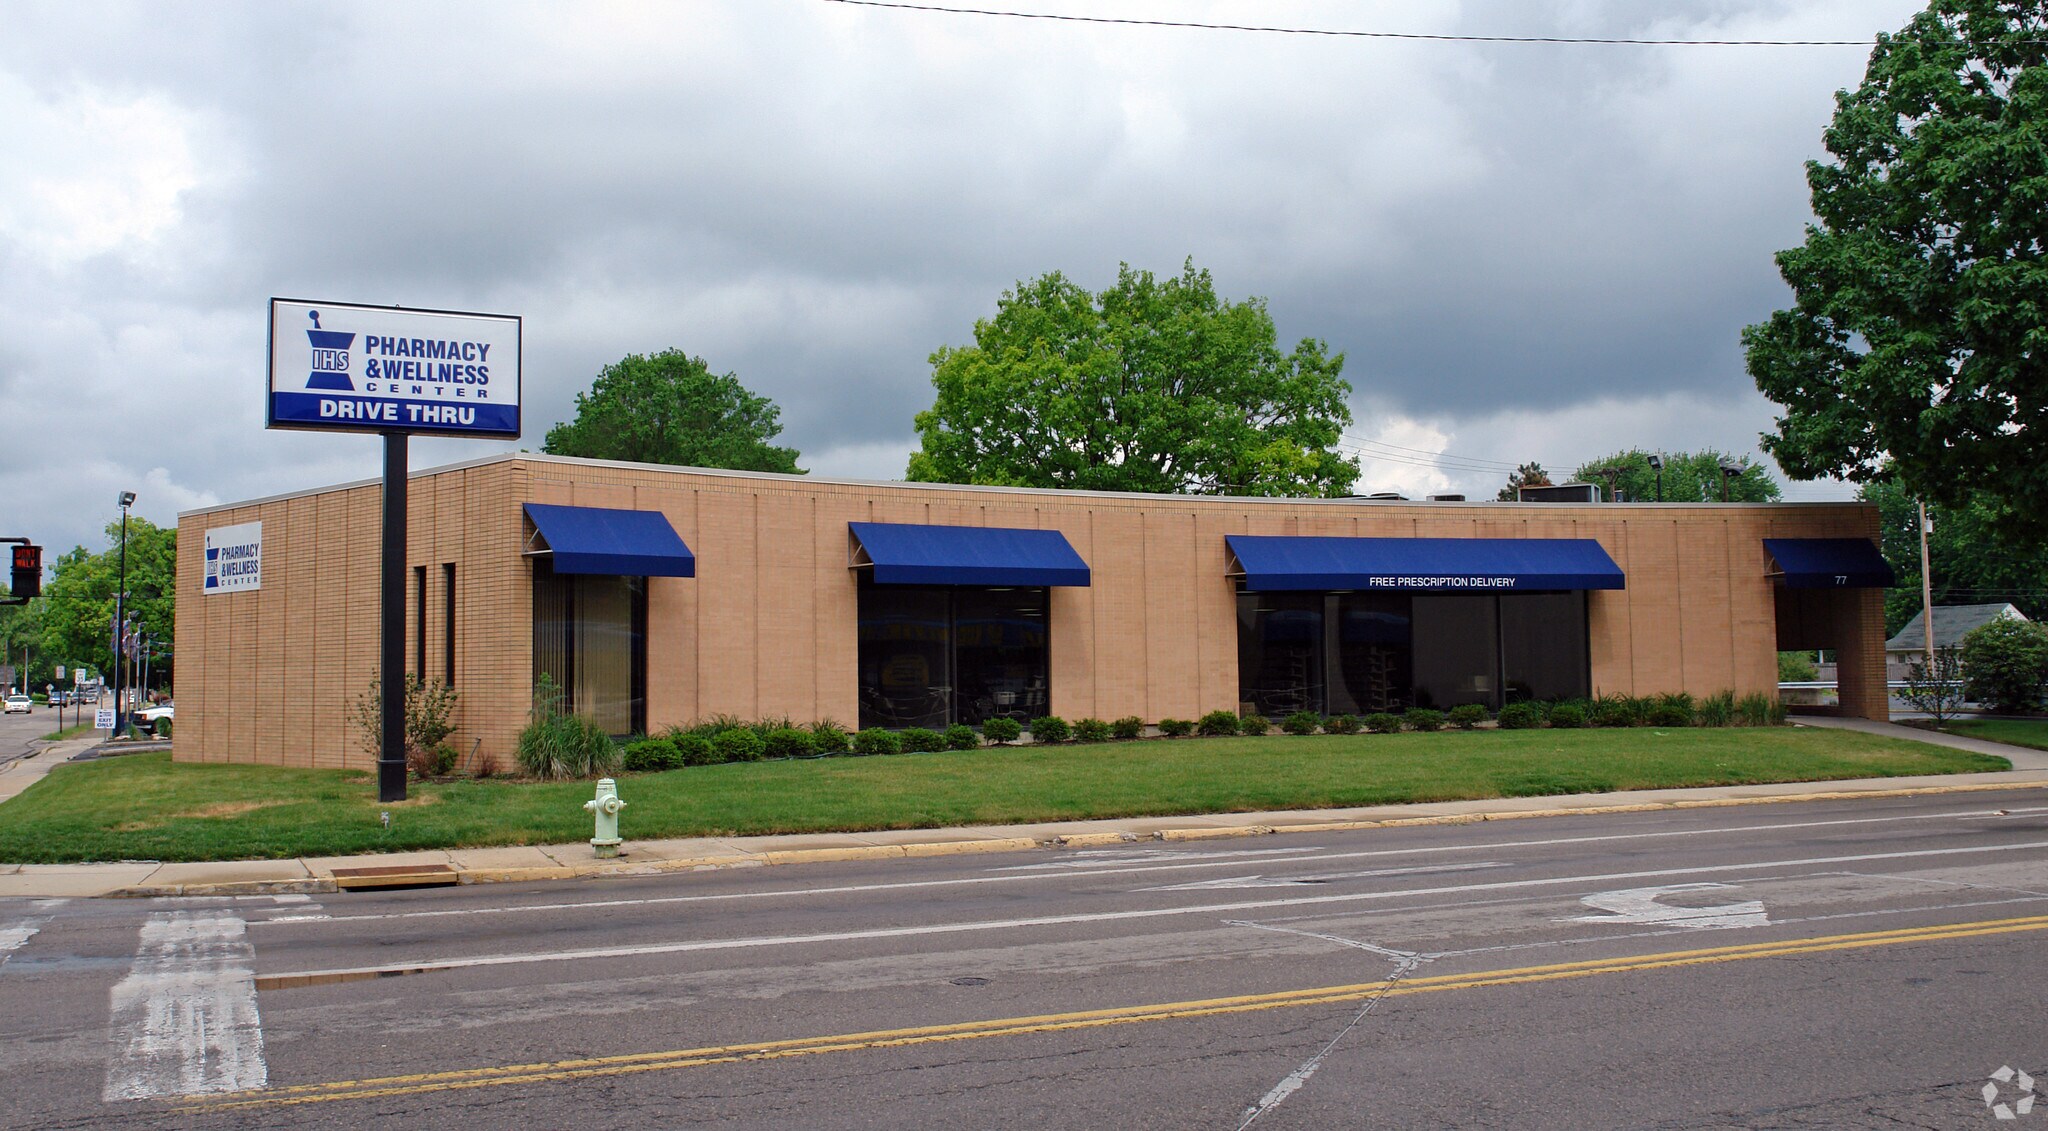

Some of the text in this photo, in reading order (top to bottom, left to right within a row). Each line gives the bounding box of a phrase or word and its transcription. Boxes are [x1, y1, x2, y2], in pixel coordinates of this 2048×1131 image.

[365, 335, 491, 362] PHARMACY
[312, 349, 350, 371] IHS
[366, 383, 488, 398] CENTER
[320, 399, 475, 425] DRIVE THRU
[221, 542, 260, 561] PHARMACY
[16, 559, 35, 568] WALK
[221, 576, 258, 587] CENTER
[1369, 576, 1516, 587] FREE PRESCRIPTION DELIVERY
[1834, 575, 1848, 585] 77
